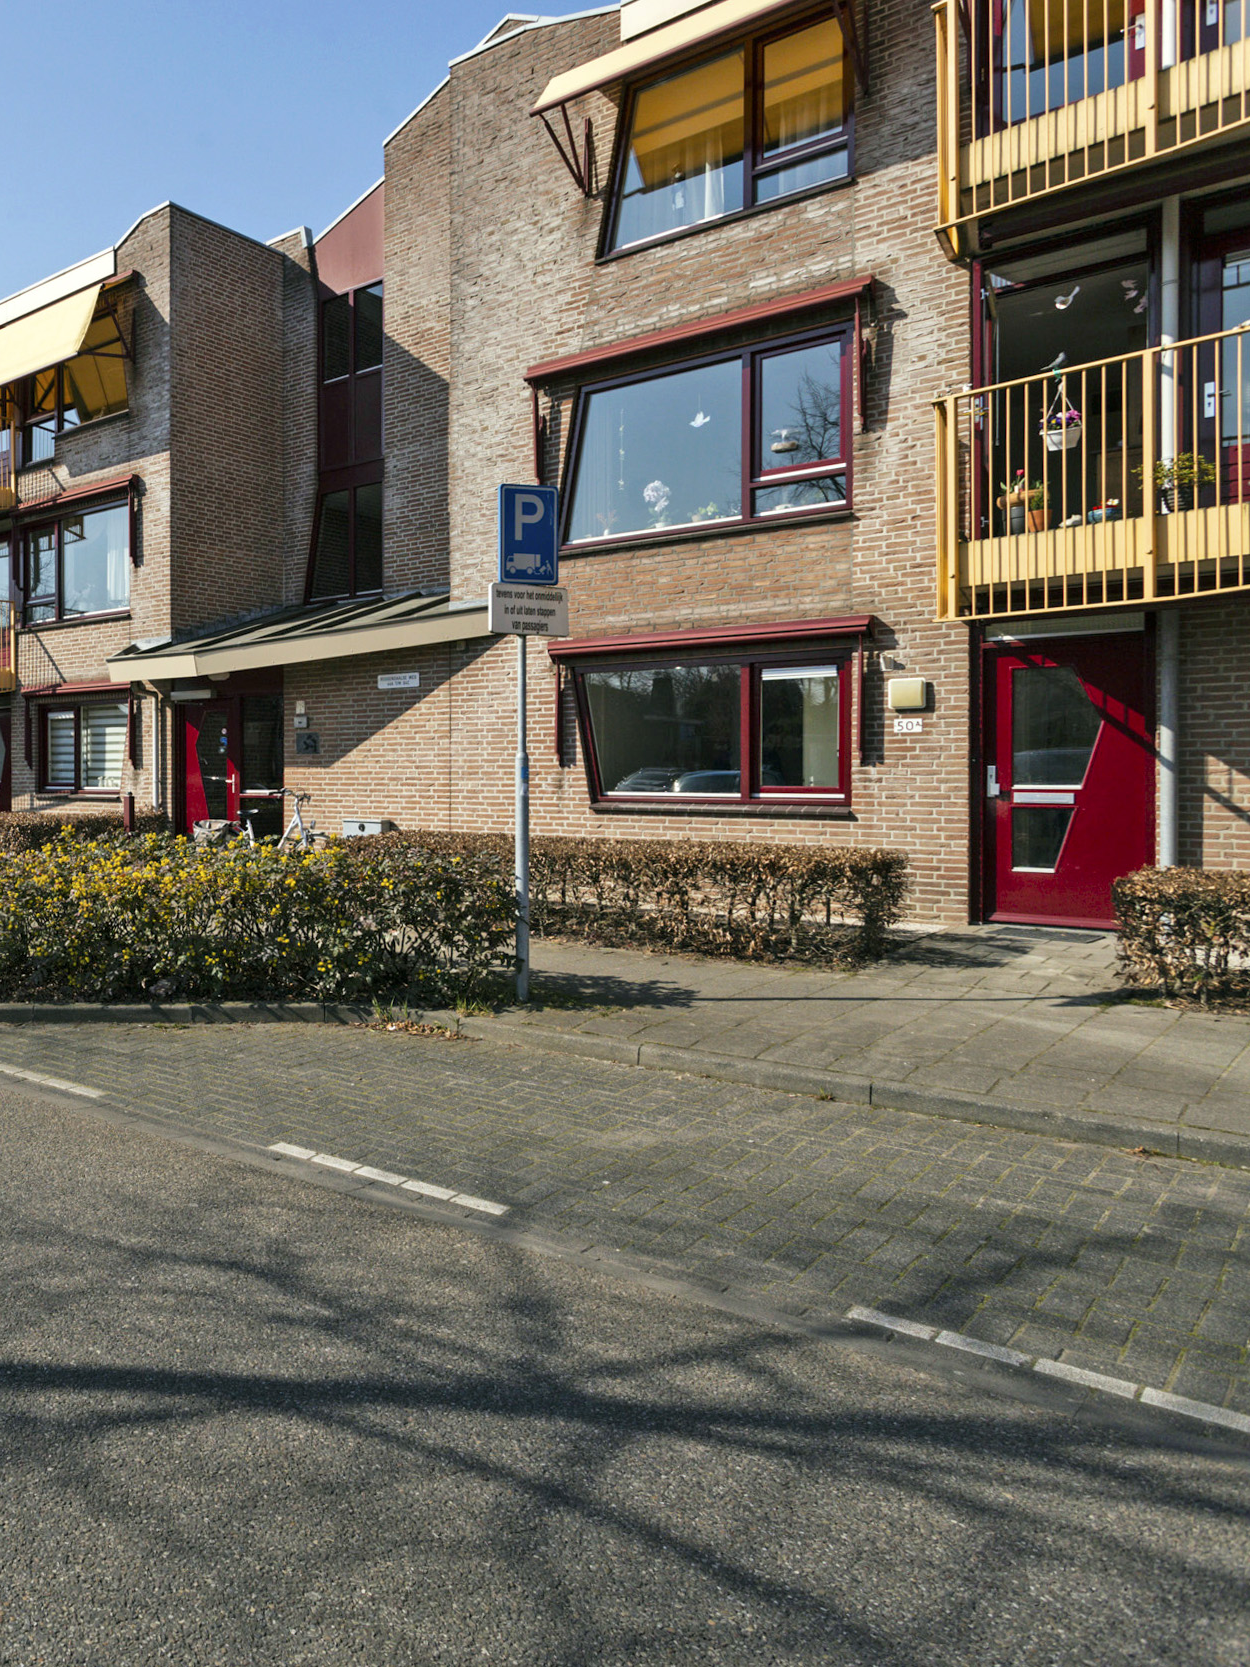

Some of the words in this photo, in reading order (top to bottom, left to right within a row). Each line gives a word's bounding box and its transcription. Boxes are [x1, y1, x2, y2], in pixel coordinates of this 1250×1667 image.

[514, 493, 545, 541] P
[496, 589, 513, 599] tevens
[514, 591, 526, 600] voor
[526, 589, 534, 600] het
[535, 591, 563, 604] onmiddellijk
[504, 604, 509, 615] in
[510, 604, 516, 615] of
[524, 605, 536, 616] laten
[537, 606, 556, 619] stappen
[512, 620, 521, 630] van
[522, 620, 549, 634] passagiers
